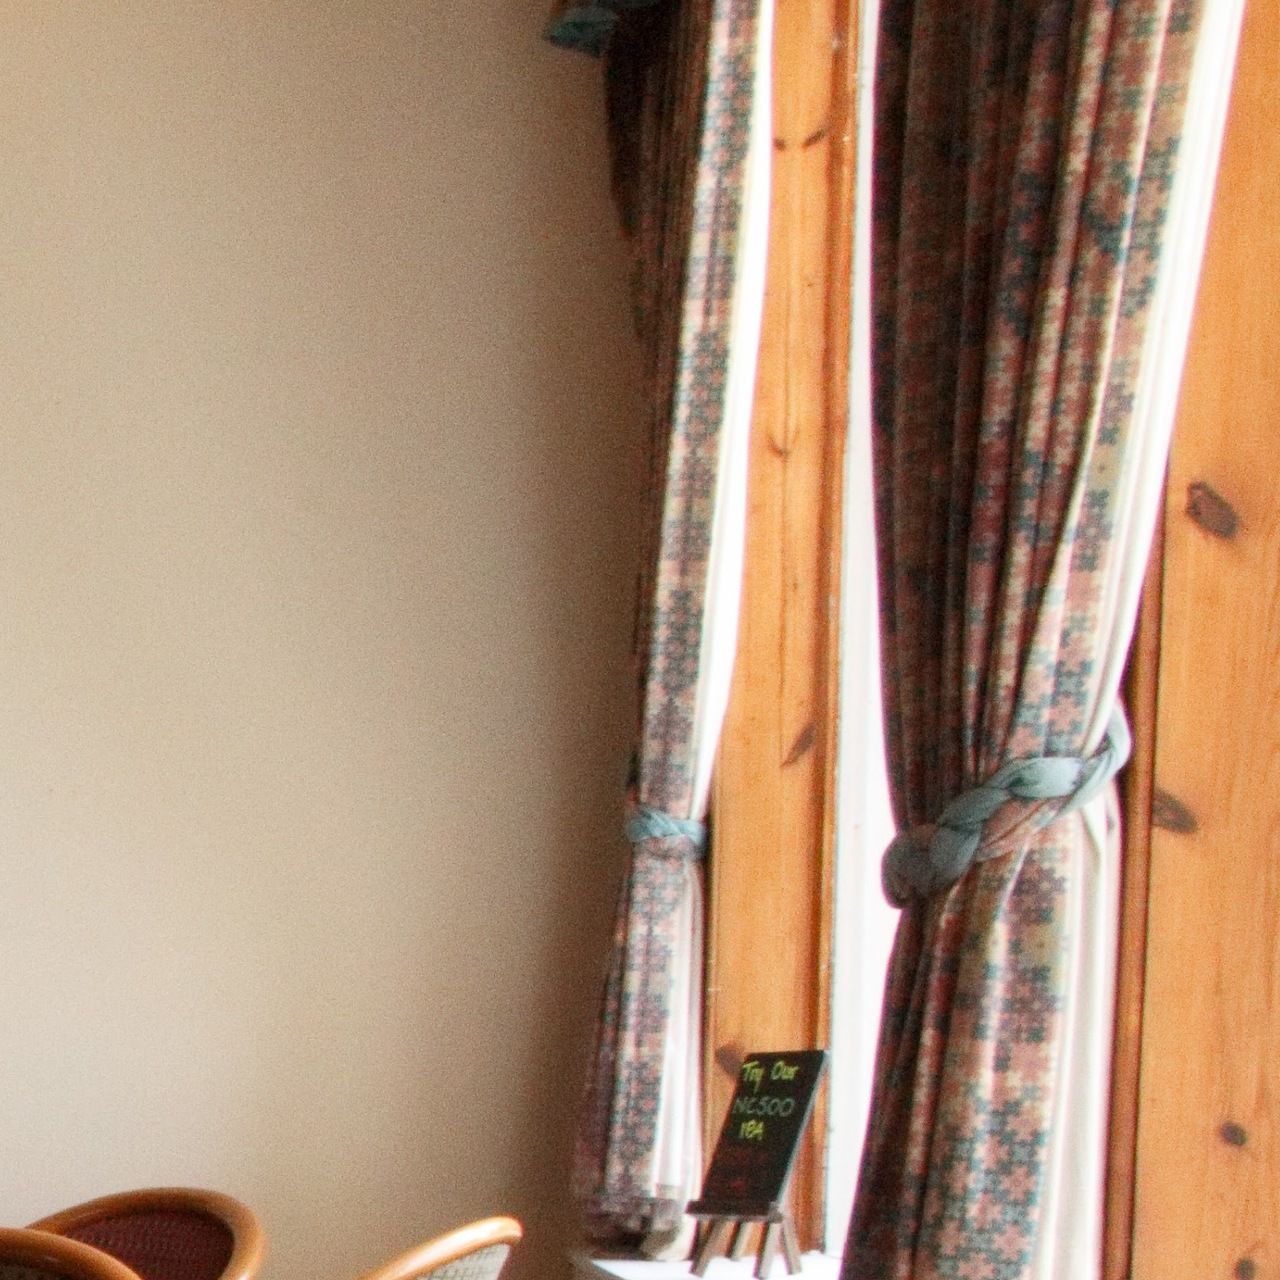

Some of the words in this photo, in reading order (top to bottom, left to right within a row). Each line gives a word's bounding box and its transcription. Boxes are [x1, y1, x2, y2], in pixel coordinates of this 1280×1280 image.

[743, 1061, 764, 1095] Try
[770, 1061, 800, 1081] Our
[732, 1096, 795, 1117] NC500
